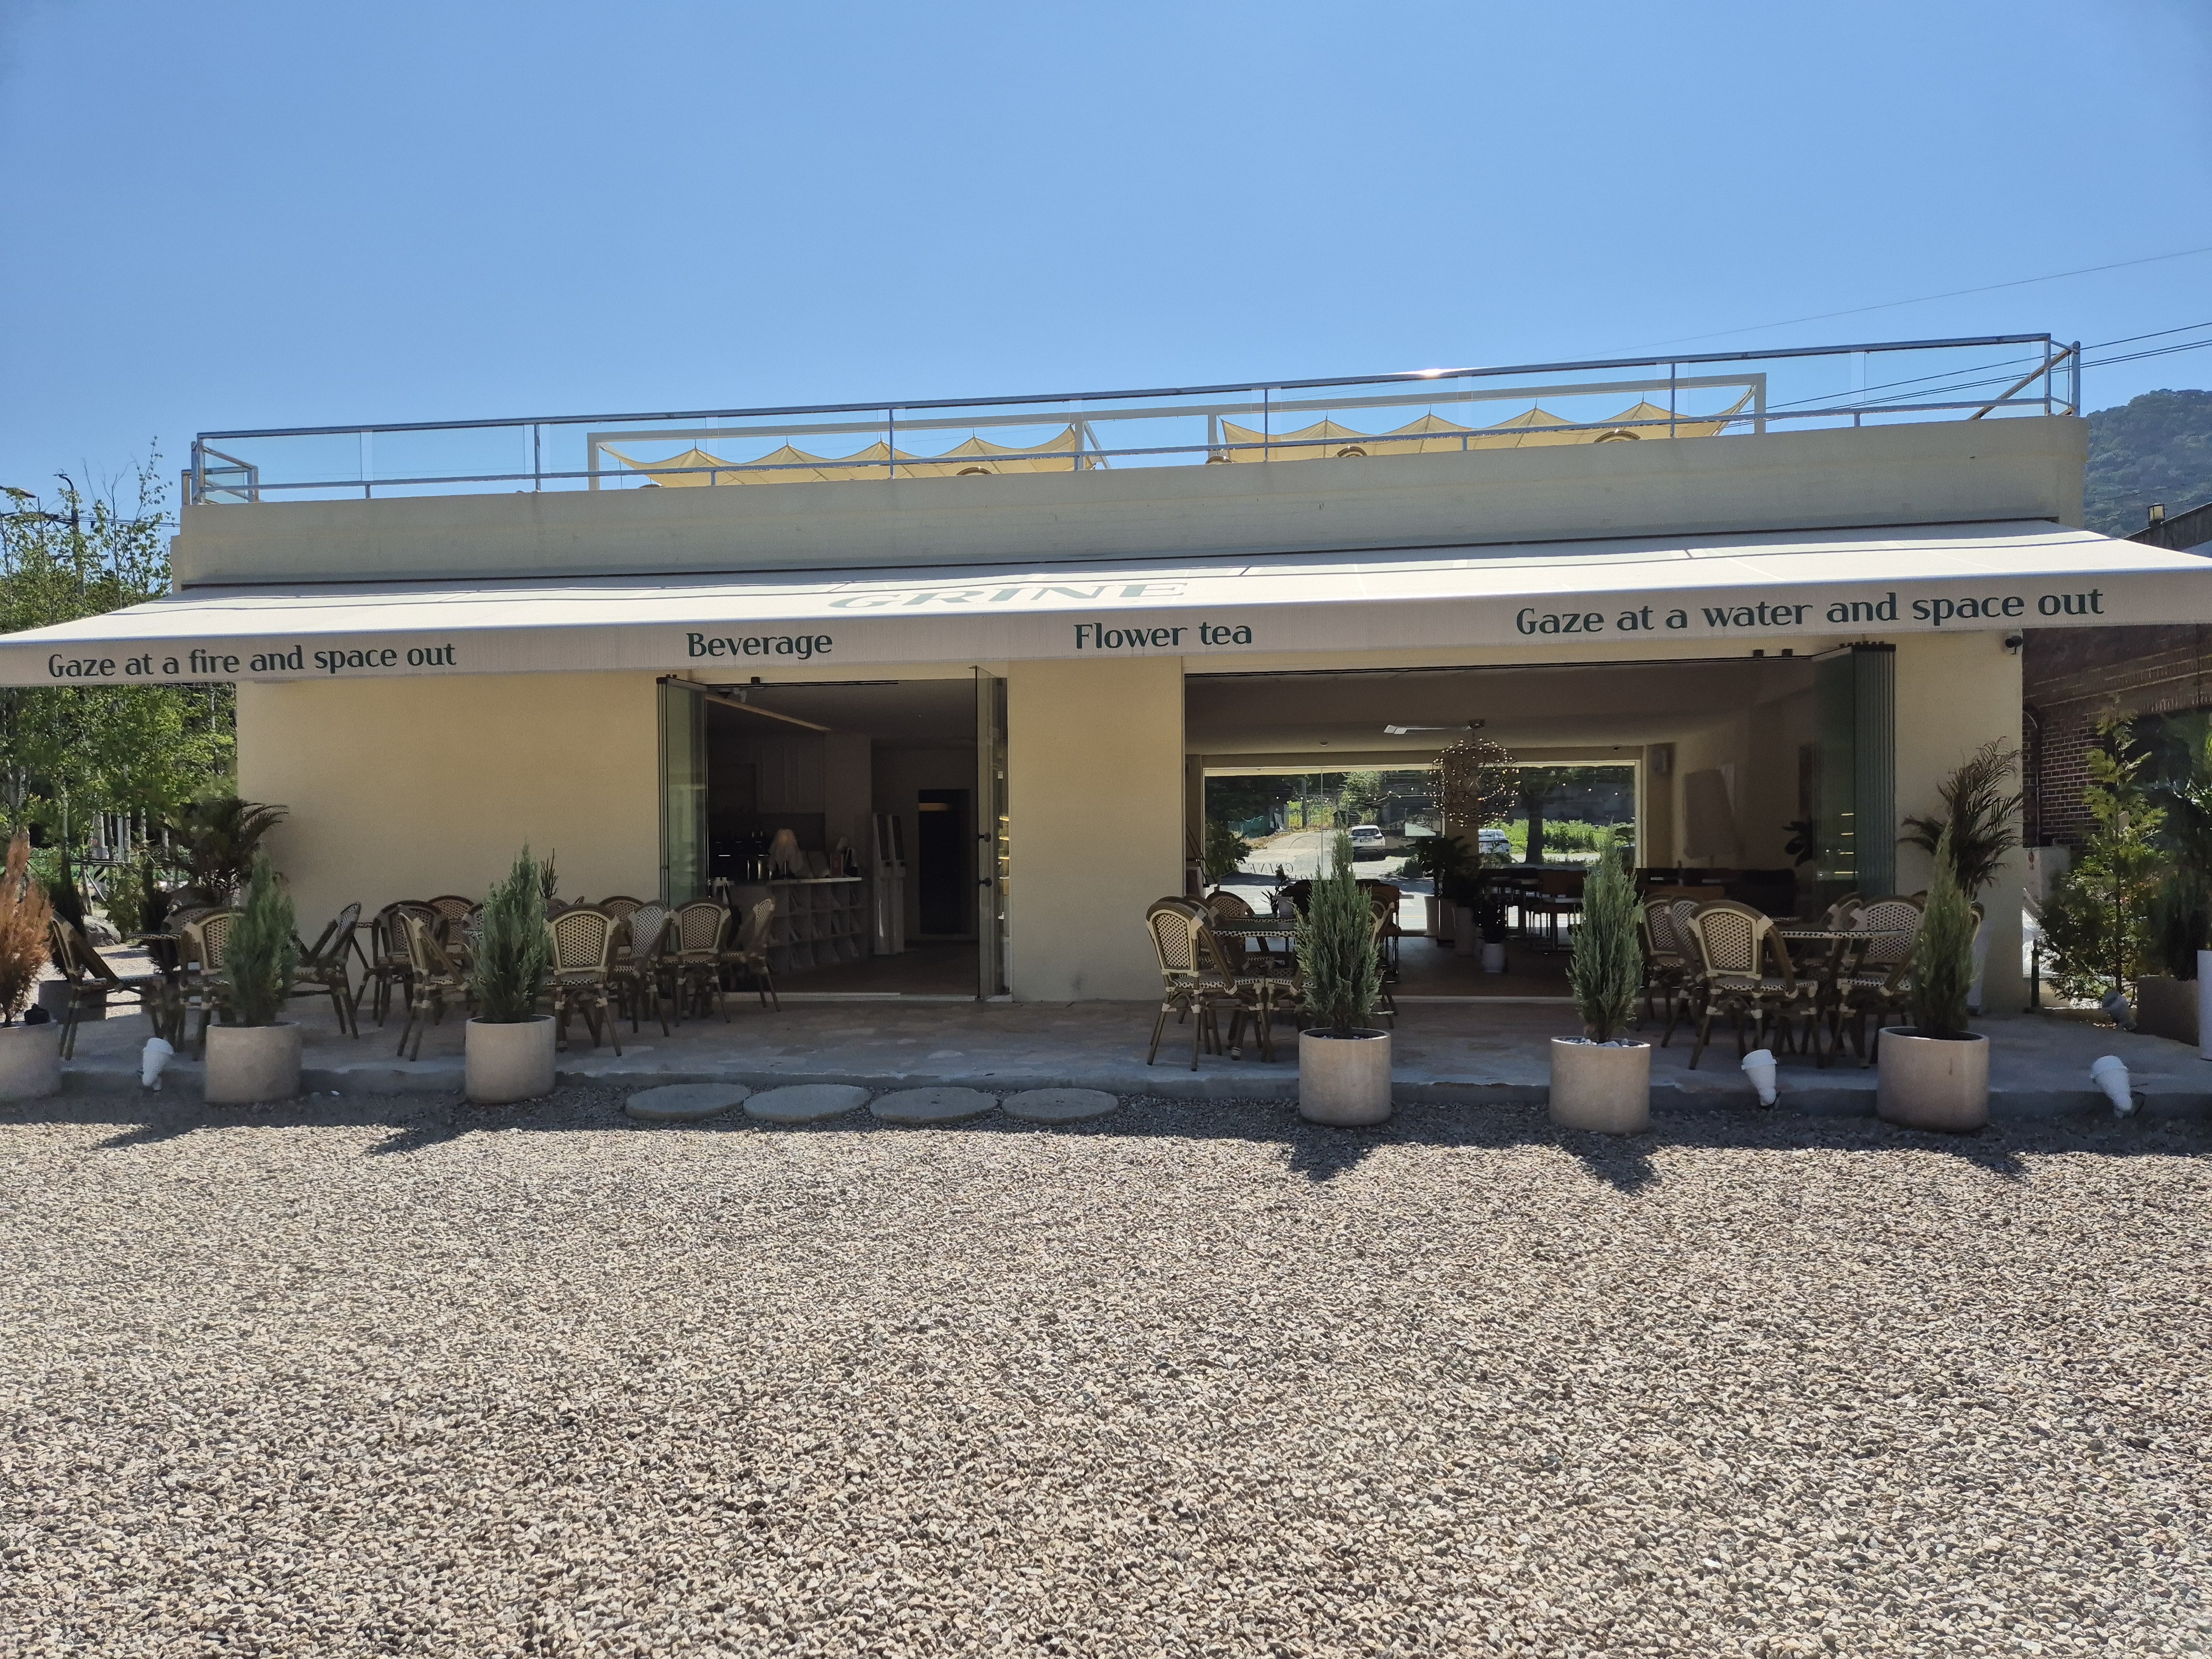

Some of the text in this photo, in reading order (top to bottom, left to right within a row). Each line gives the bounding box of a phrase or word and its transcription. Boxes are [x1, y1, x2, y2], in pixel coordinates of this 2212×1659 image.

[828, 582, 1188, 608] GRINE
[1516, 588, 2105, 635] Gaze at a water and space out
[685, 633, 833, 660] Beverage
[1073, 622, 1252, 649] Flower tea
[48, 643, 457, 678] Gaze at a fire and space out
